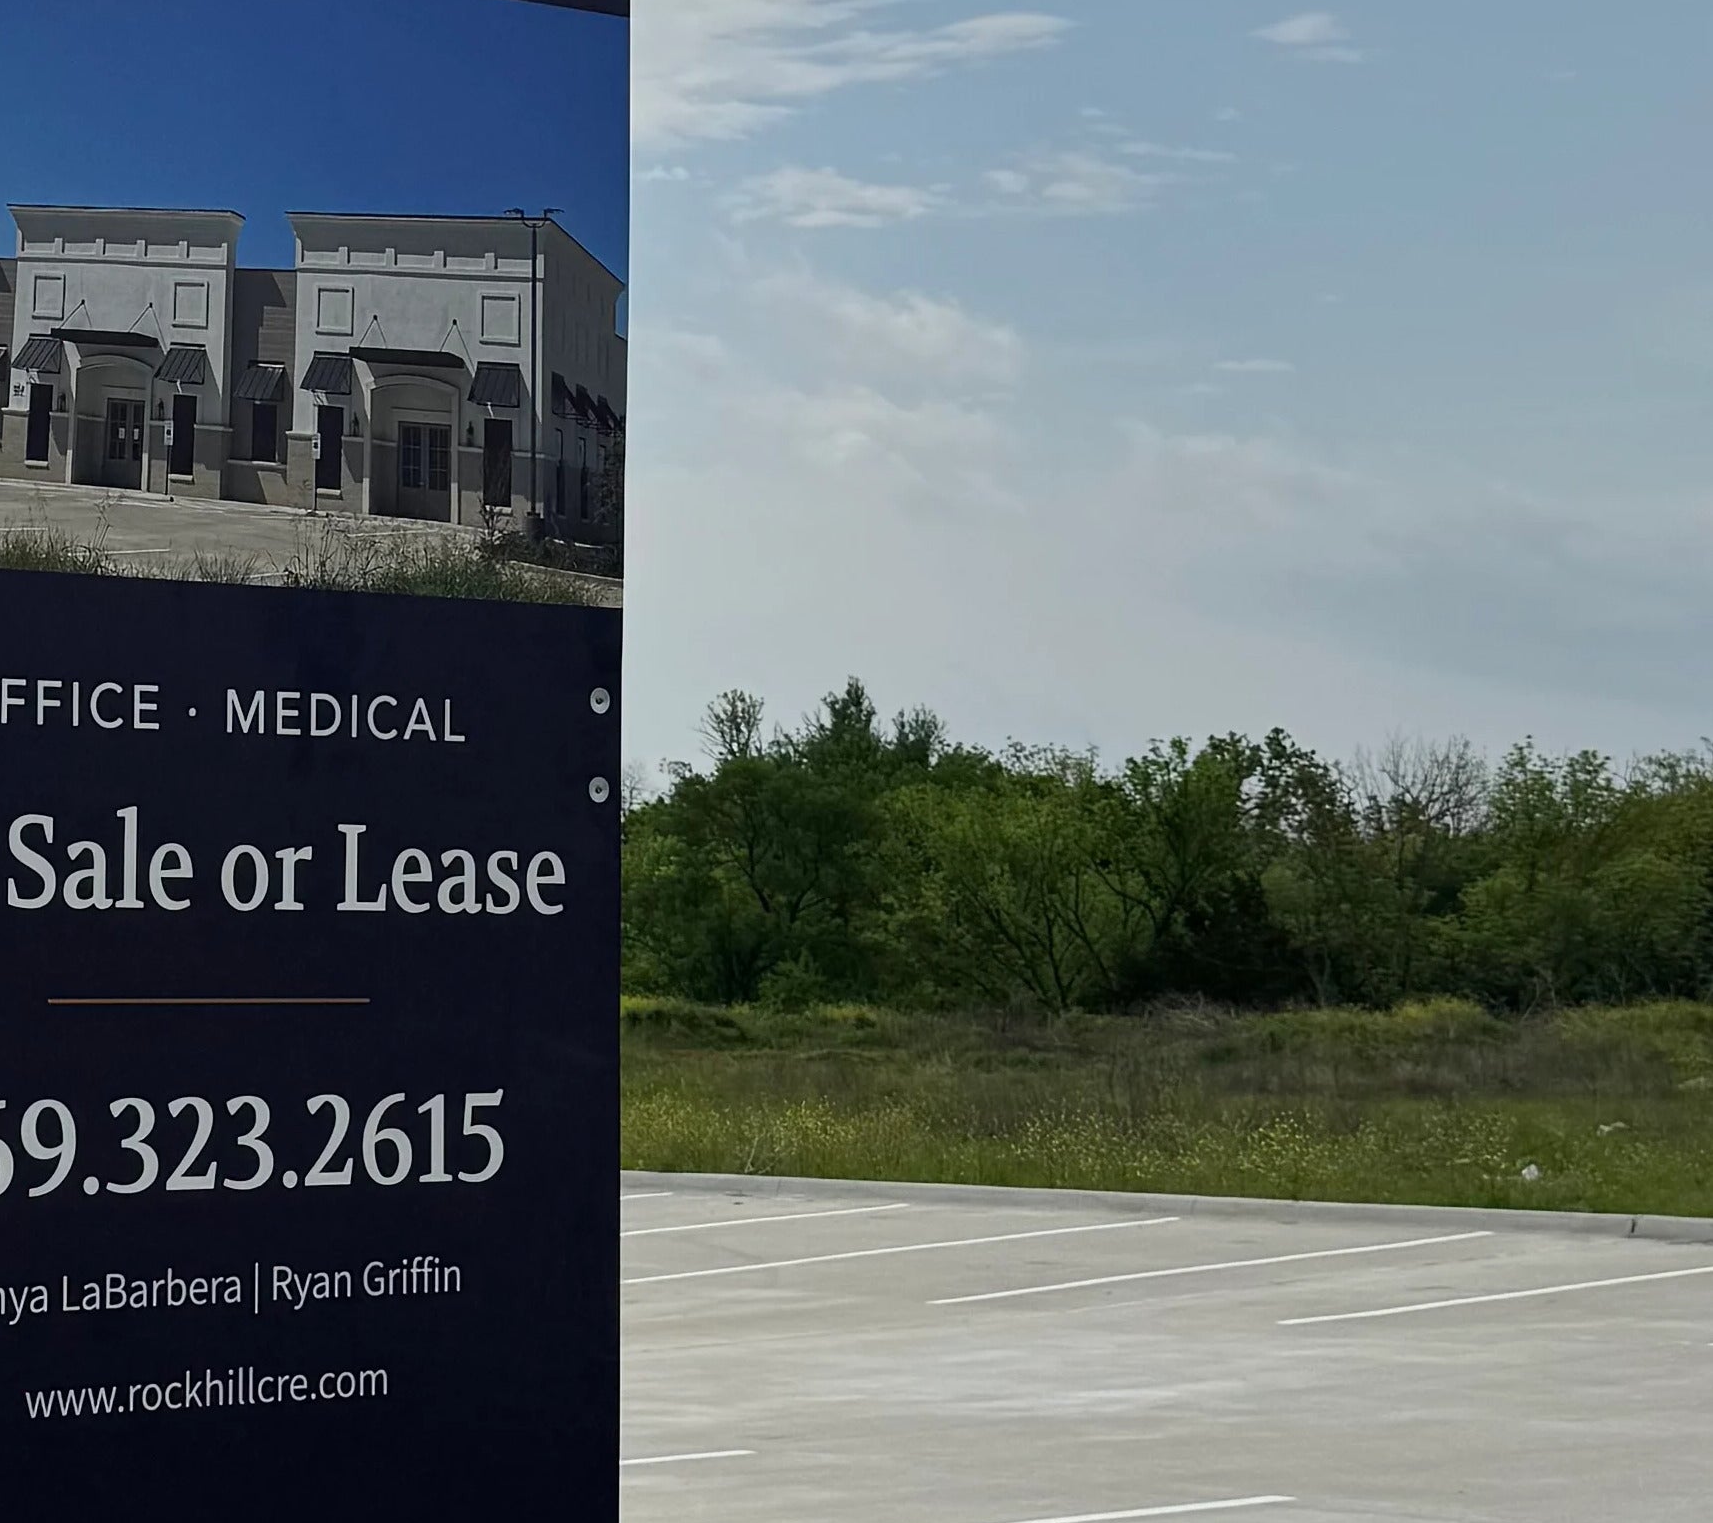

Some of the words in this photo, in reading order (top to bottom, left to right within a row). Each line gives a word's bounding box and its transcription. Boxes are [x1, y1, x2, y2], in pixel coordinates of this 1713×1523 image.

[226, 688, 466, 742] MEDICAL
[7, 805, 194, 911] Sale
[220, 844, 313, 912] or
[336, 823, 566, 915] Lease
[62, 1267, 241, 1312] LaBarbera
[272, 1265, 352, 1311] Ryan
[363, 1255, 461, 1297] Griffin
[25, 1366, 388, 1419] www.rockhillcre.com
